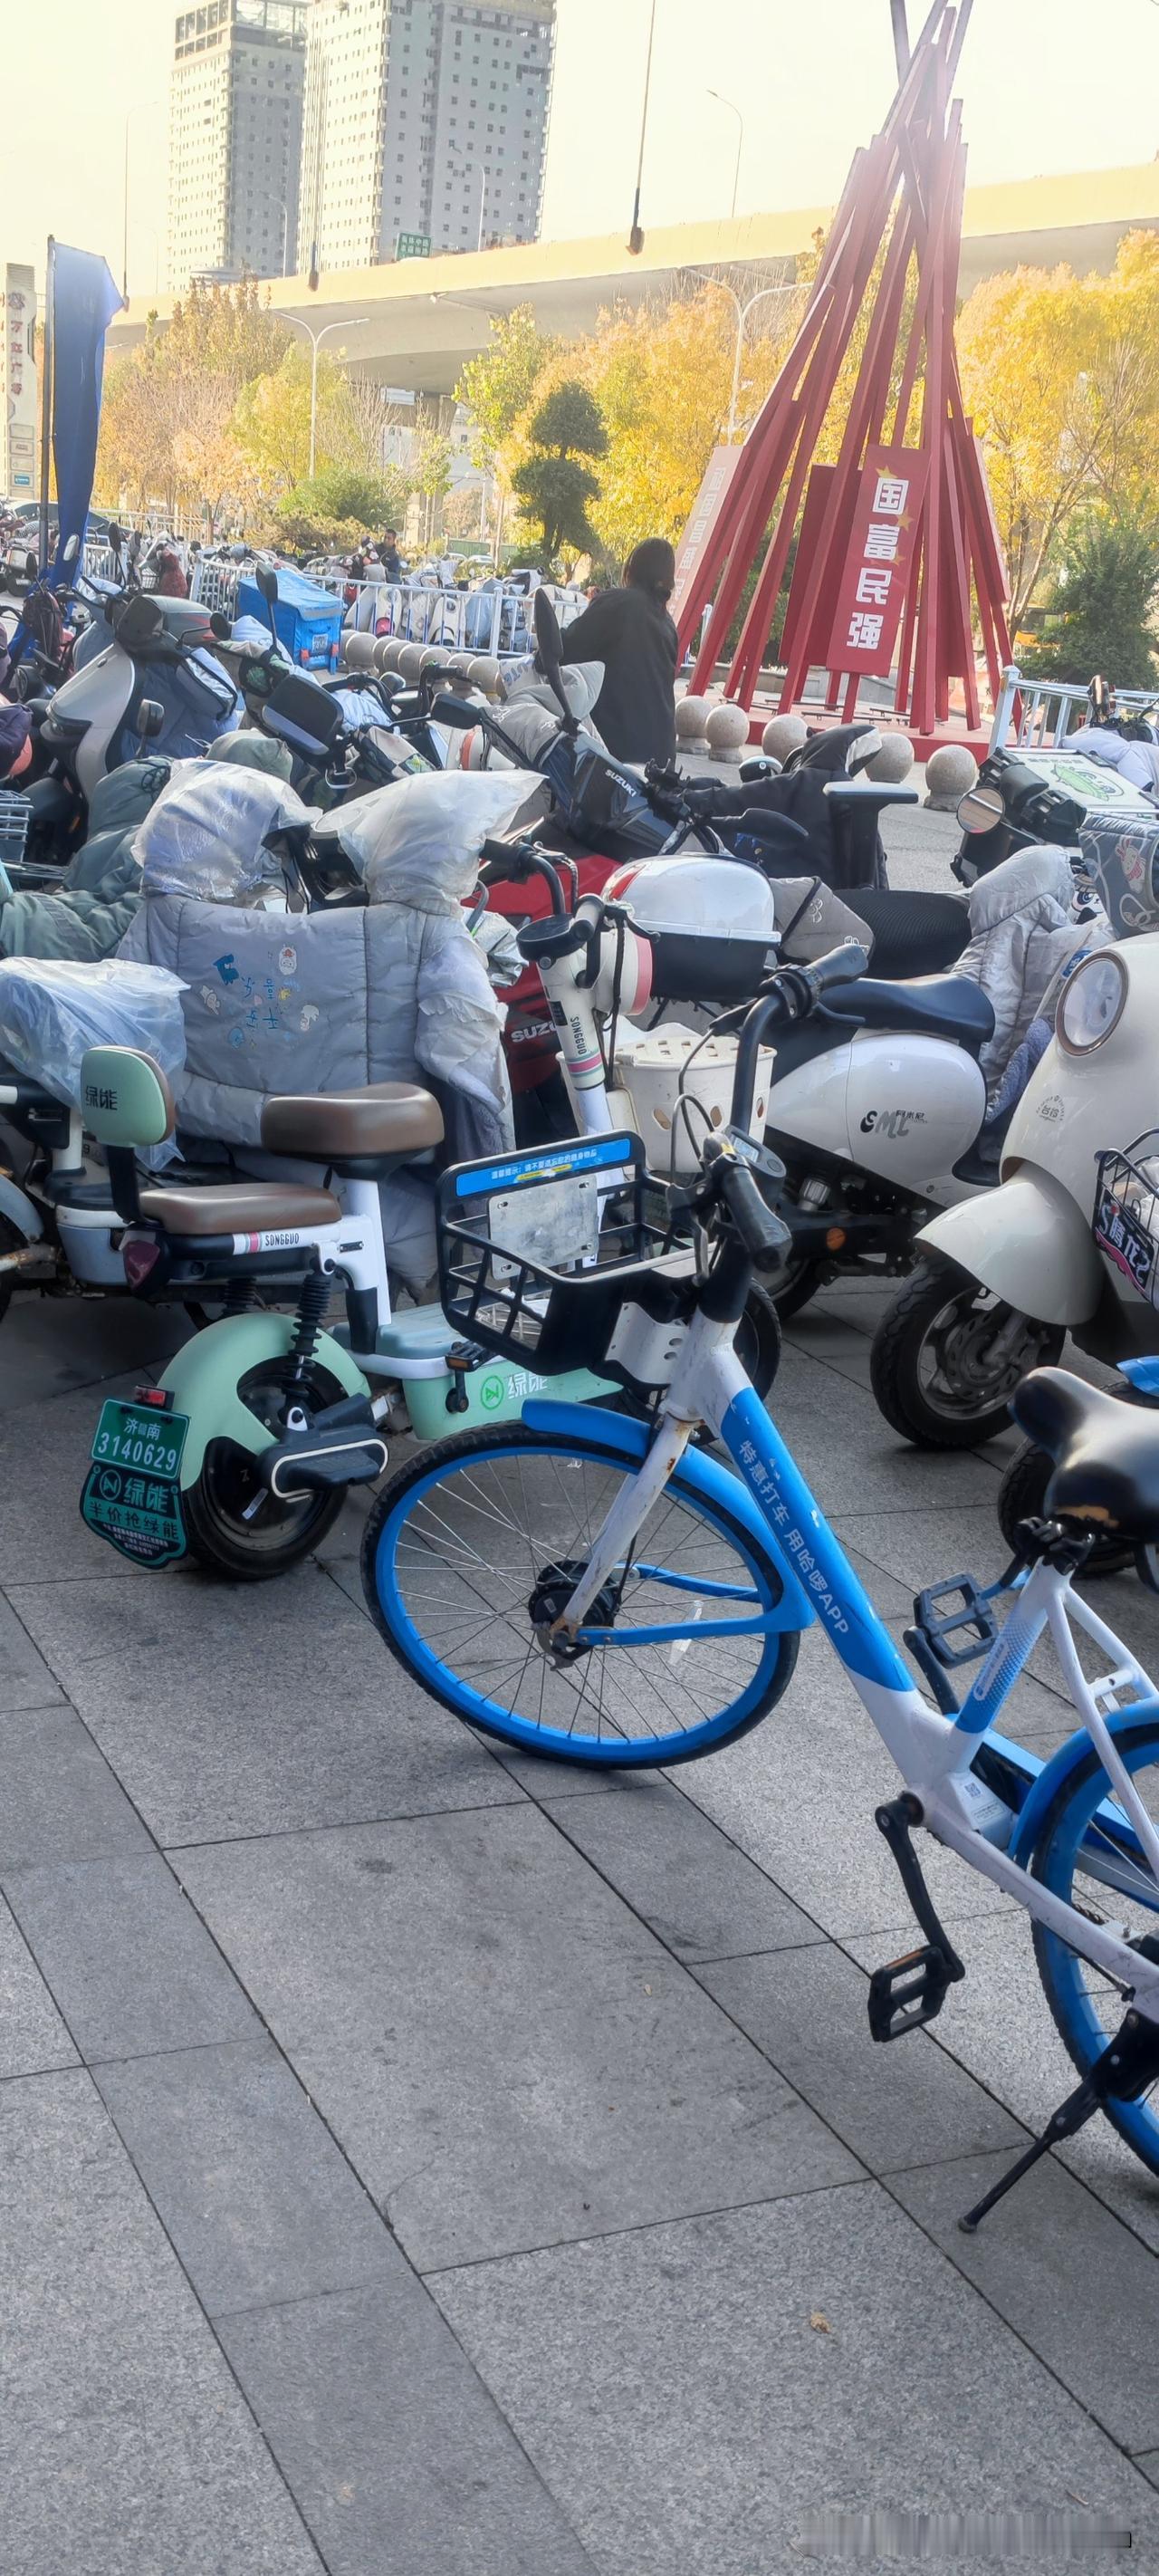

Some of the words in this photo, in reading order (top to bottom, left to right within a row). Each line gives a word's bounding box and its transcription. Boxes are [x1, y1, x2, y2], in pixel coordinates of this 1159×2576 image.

[846, 476, 910, 650] 国富民强
[605, 769, 637, 797] SUZUKI
[570, 1015, 588, 1055] SONGGUO
[85, 1085, 118, 1111] 绿能
[264, 1232, 300, 1246] SONGGUO
[507, 1371, 549, 1399] 绿能
[123, 1417, 162, 1441] 济南
[97, 1431, 177, 1472] 3140629
[122, 1477, 170, 1514] 绿能
[738, 1439, 790, 1527] 特惠打车
[90, 1501, 179, 1540] 半价抢绿能
